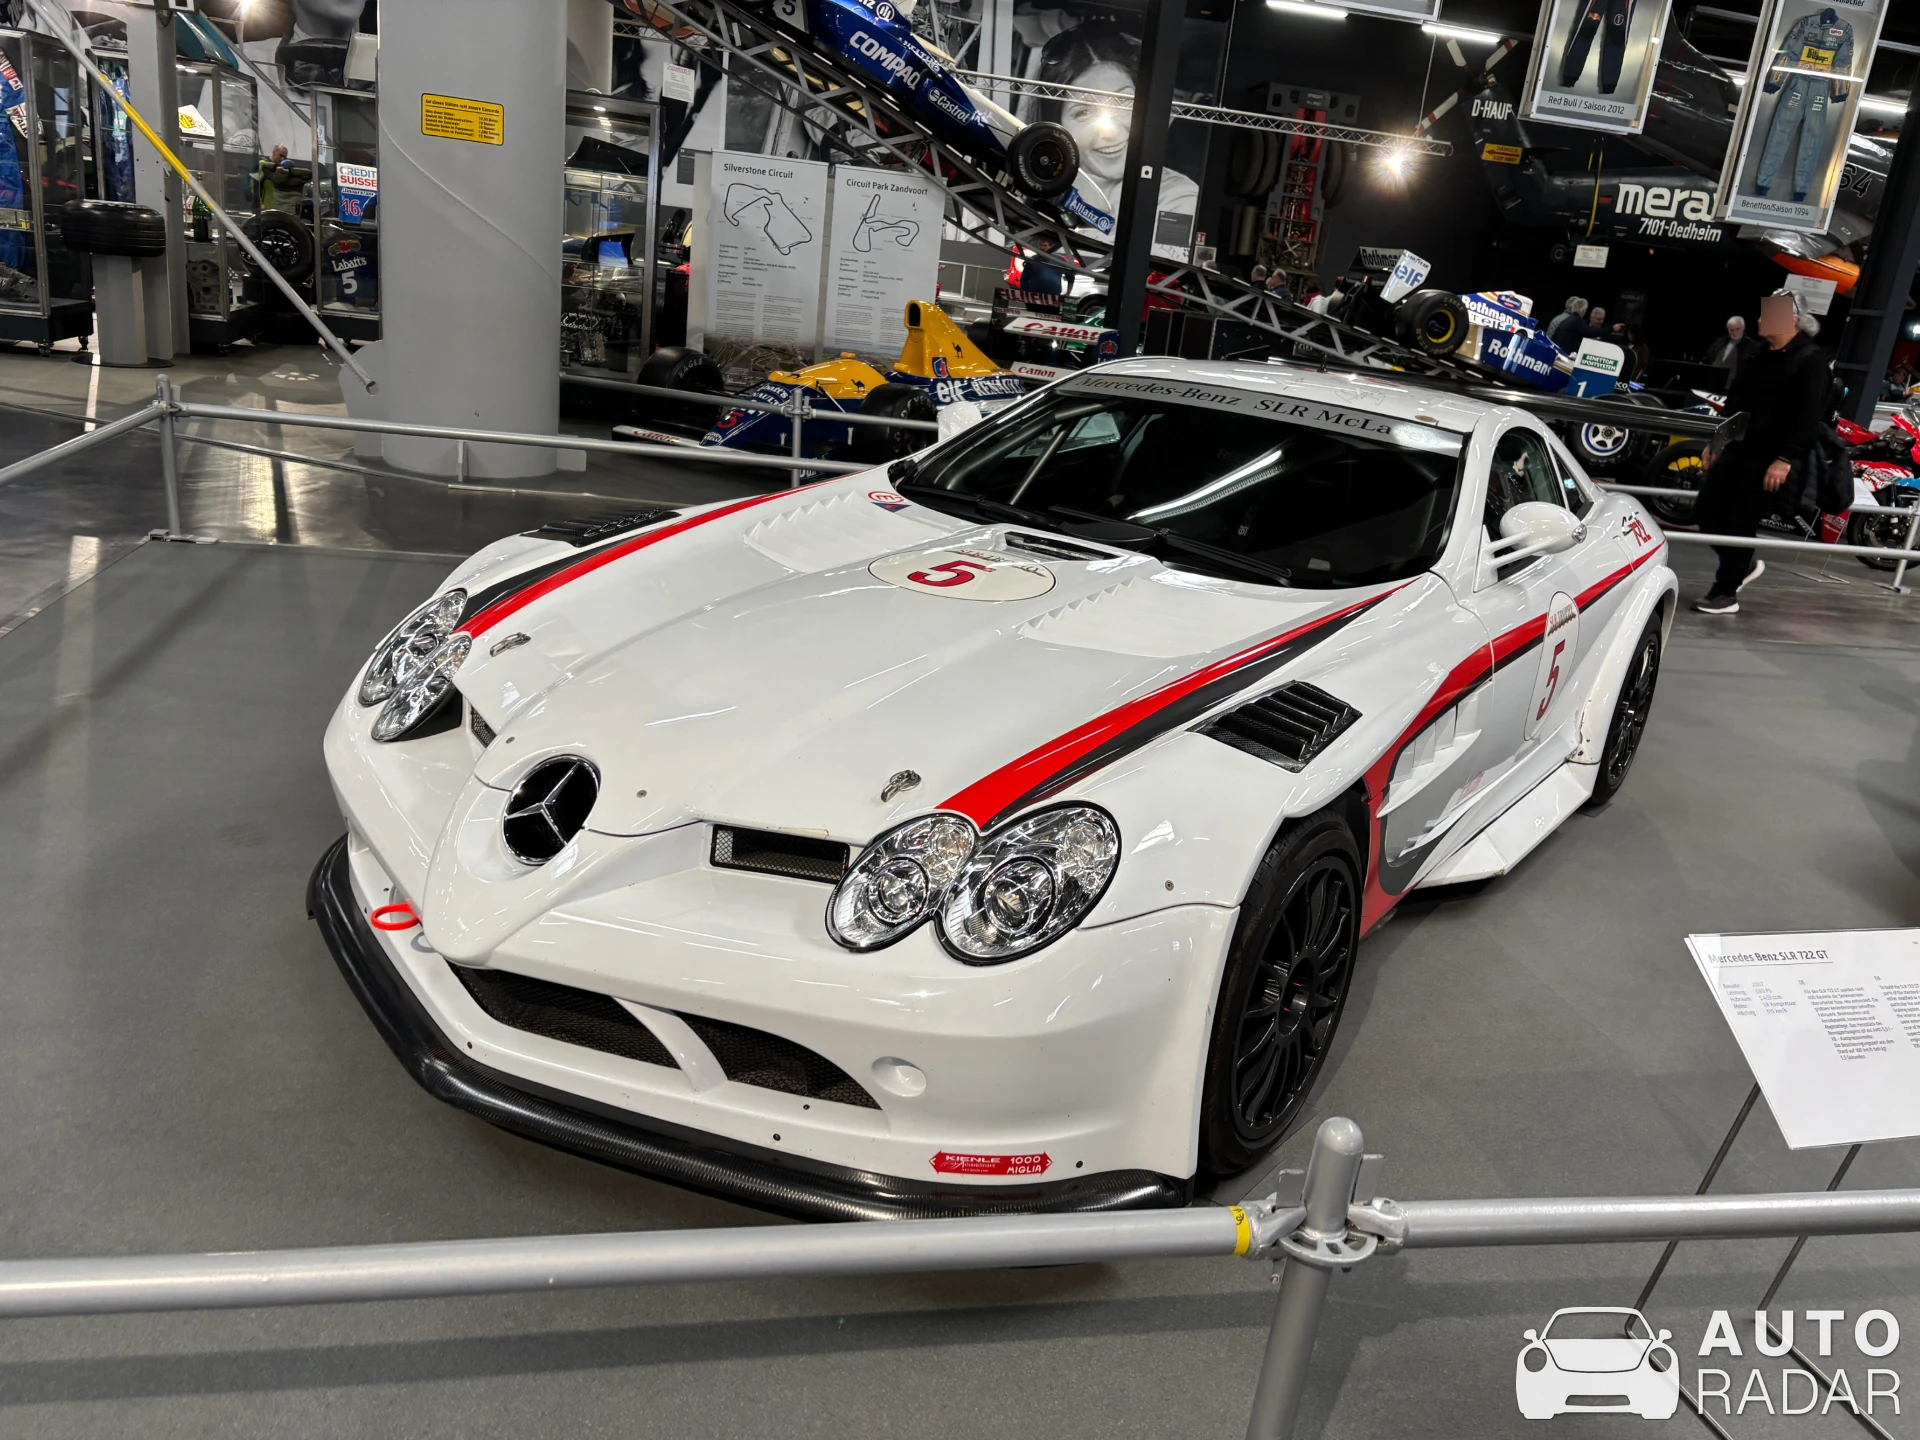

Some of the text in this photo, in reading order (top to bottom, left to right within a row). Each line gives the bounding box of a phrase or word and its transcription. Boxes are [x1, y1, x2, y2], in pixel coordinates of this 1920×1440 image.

[850, 31, 921, 91] COMPAQ
[937, 97, 970, 123] Castrol
[1548, 96, 1562, 105] Red
[1563, 98, 1577, 107] Bull
[1583, 101, 1606, 112] Saison
[1607, 104, 1625, 114] 2012
[340, 166, 377, 179] CREDIT
[340, 175, 377, 188] SUISSE
[724, 163, 793, 179] Silverstone Circuit
[846, 178, 928, 195] Circuit Park Zandvoort
[343, 198, 361, 216] 16
[1070, 199, 1099, 223] Allianz
[1615, 183, 1717, 223] mera
[1741, 199, 1809, 216] Benetton/Saison 1994
[1638, 217, 1722, 242] 7101-Oedheim
[331, 256, 367, 272] Labatt's
[341, 270, 358, 294] 5
[1395, 264, 1424, 287] elf
[1461, 294, 1520, 327] Rothmans
[677, 357, 704, 378] EAGLE
[1488, 338, 1552, 376] Rothmans
[1018, 366, 1056, 378] Canon
[936, 380, 967, 403] elf
[1075, 377, 1243, 406] Mercedes-Benz
[1253, 399, 1309, 417] SLR
[1577, 381, 1587, 398] 1
[907, 559, 997, 588] 5
[1536, 639, 1566, 721] 5
[1708, 950, 1829, 963] Mercedes Benz SLR 722 GT
[945, 1155, 1041, 1164] KIENLE 1000
[1006, 1165, 1042, 1174] MIGLIA
